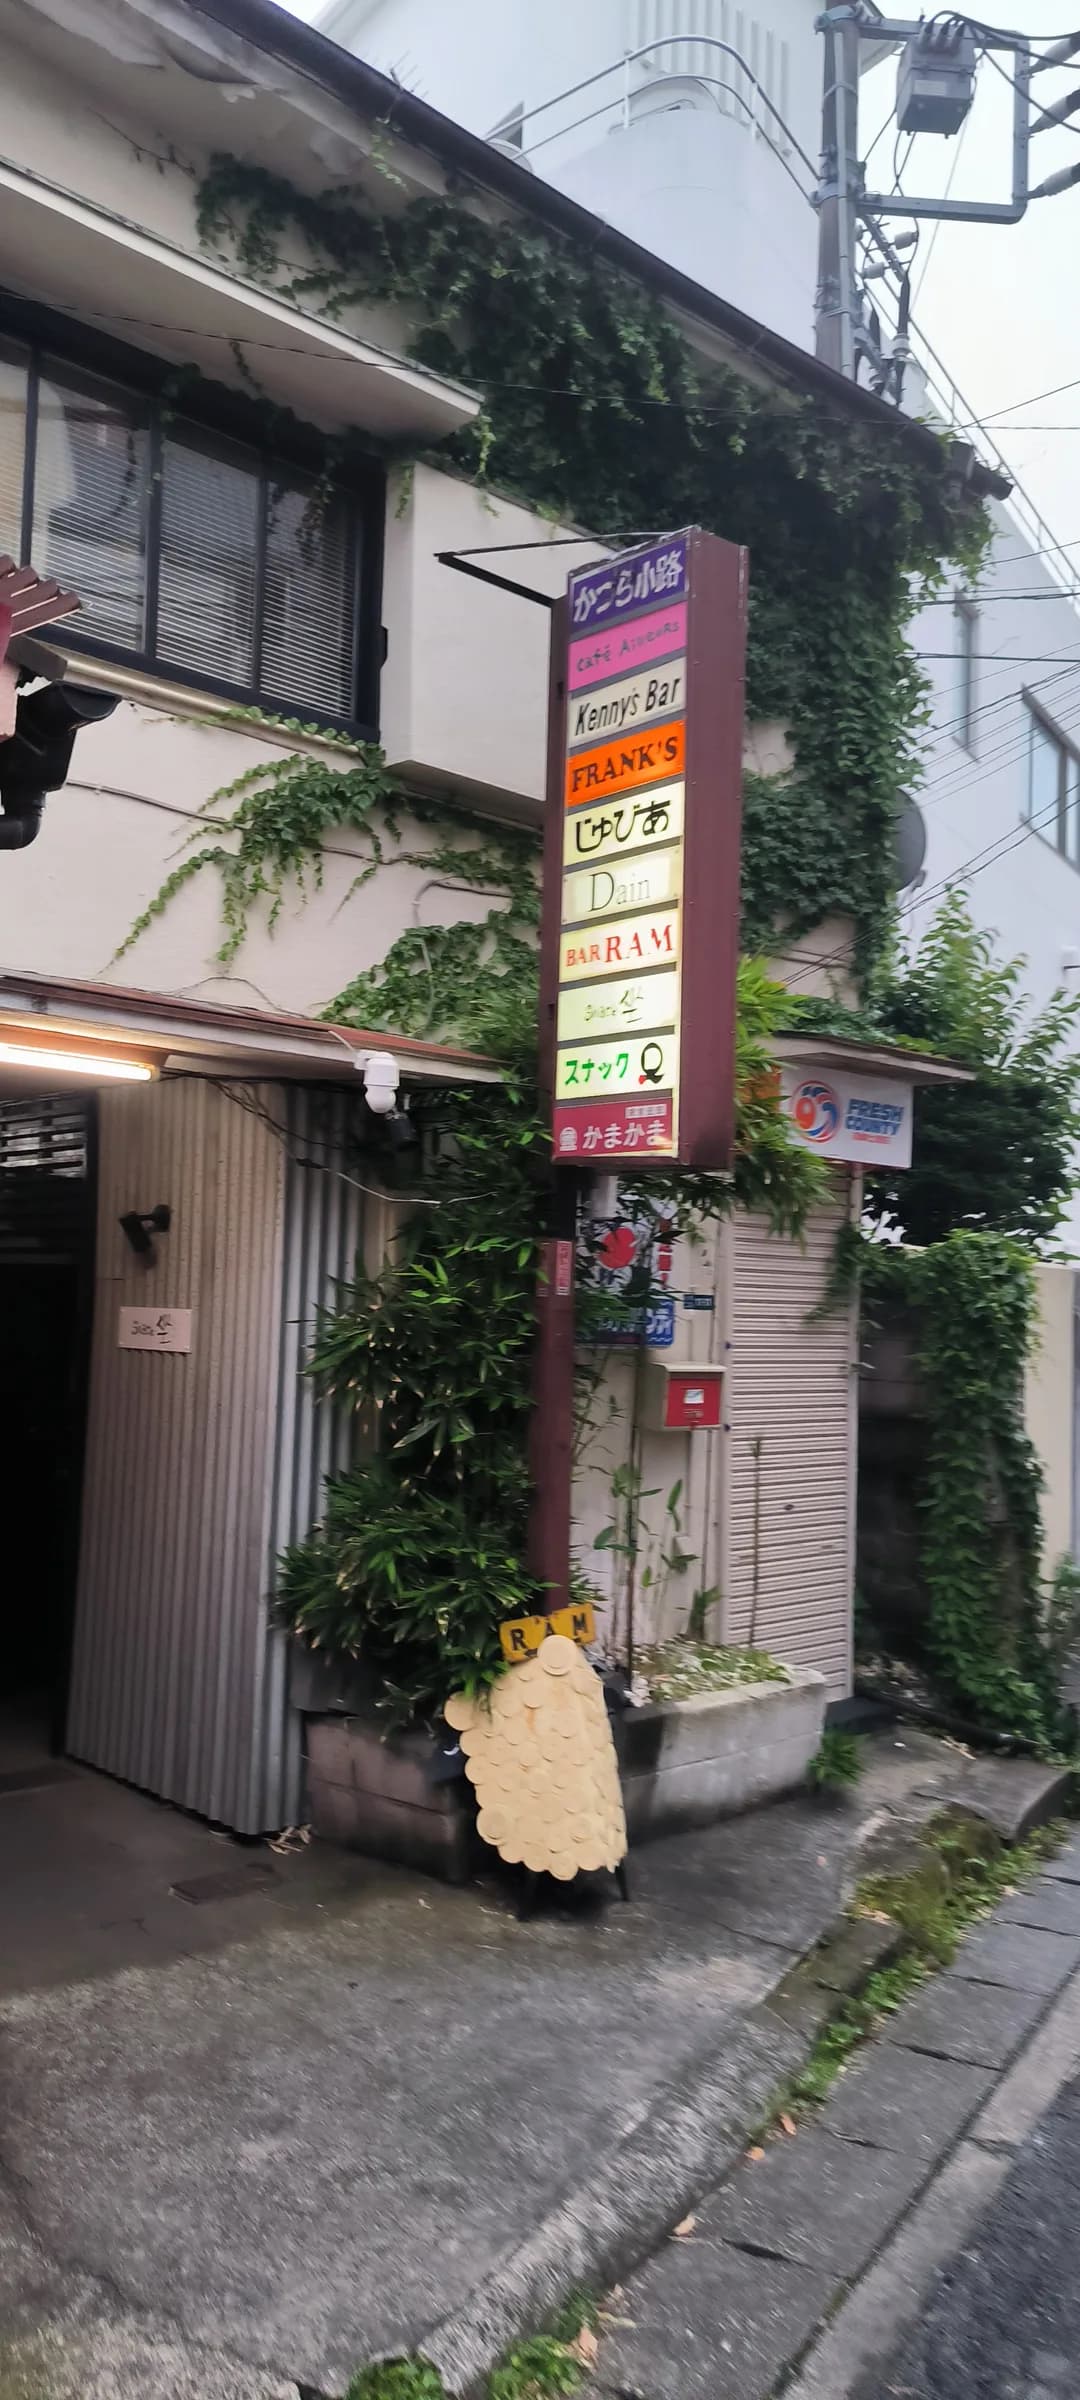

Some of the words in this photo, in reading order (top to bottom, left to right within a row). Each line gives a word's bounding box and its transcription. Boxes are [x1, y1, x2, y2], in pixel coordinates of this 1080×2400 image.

[574, 687, 641, 737] Kenny's
[645, 678, 681, 713] Bar
[571, 736, 678, 794] FRANK'S
[588, 871, 651, 912] Dain
[565, 944, 600, 968] BAR
[604, 924, 674, 963] RAM
[564, 1052, 630, 1086] スナック
[639, 1042, 665, 1085] Q
[848, 1098, 904, 1123] FRESH
[582, 1119, 667, 1150] かまかま
